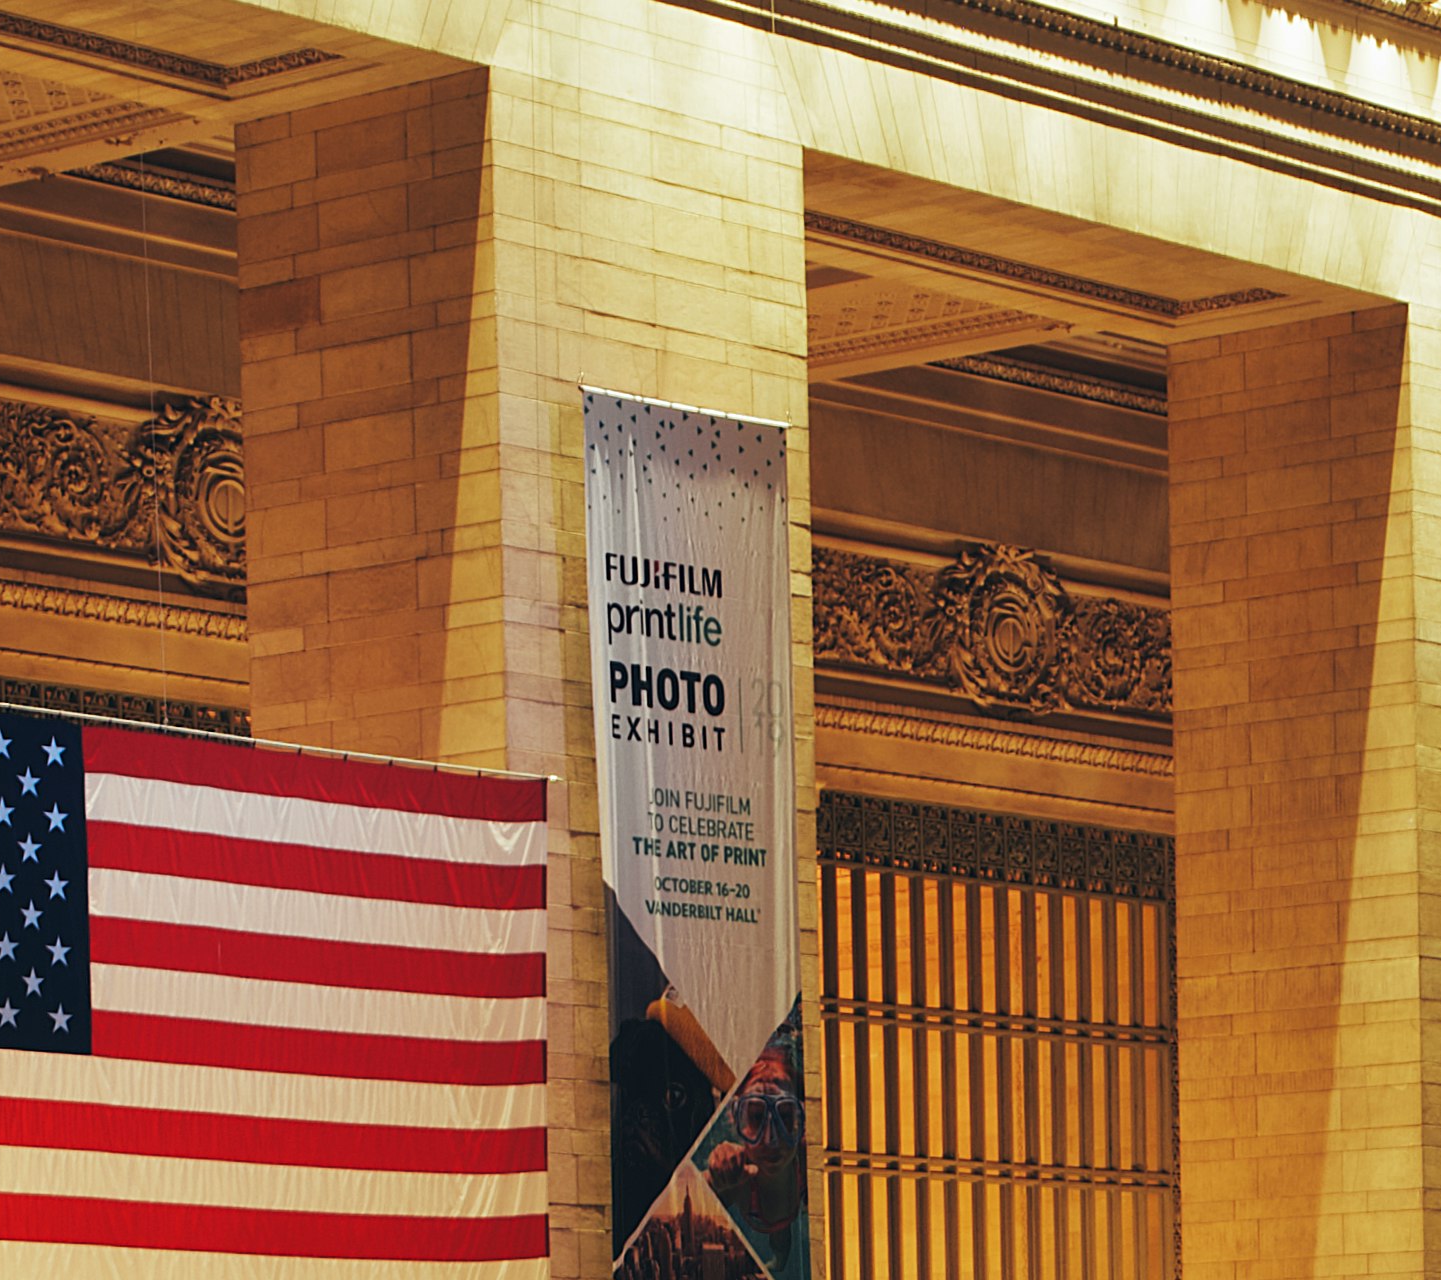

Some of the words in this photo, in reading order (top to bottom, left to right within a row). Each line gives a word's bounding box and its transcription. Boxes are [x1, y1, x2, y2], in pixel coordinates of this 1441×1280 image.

[606, 552, 722, 599] FUJIFILM
[607, 600, 722, 647] printlife
[610, 661, 725, 716] PHOTO
[611, 714, 725, 752] EXHIBIT
[648, 788, 680, 809] OIN
[685, 791, 751, 815] FUJIFILM
[669, 815, 754, 841] CELEBRATE
[632, 836, 662, 857] THE
[666, 840, 696, 860] ART
[701, 844, 719, 862] OF
[724, 846, 767, 867] PRINT
[655, 876, 713, 894] OCTOBER
[717, 882, 750, 898] 16-20
[645, 900, 722, 920] VANDERBILT
